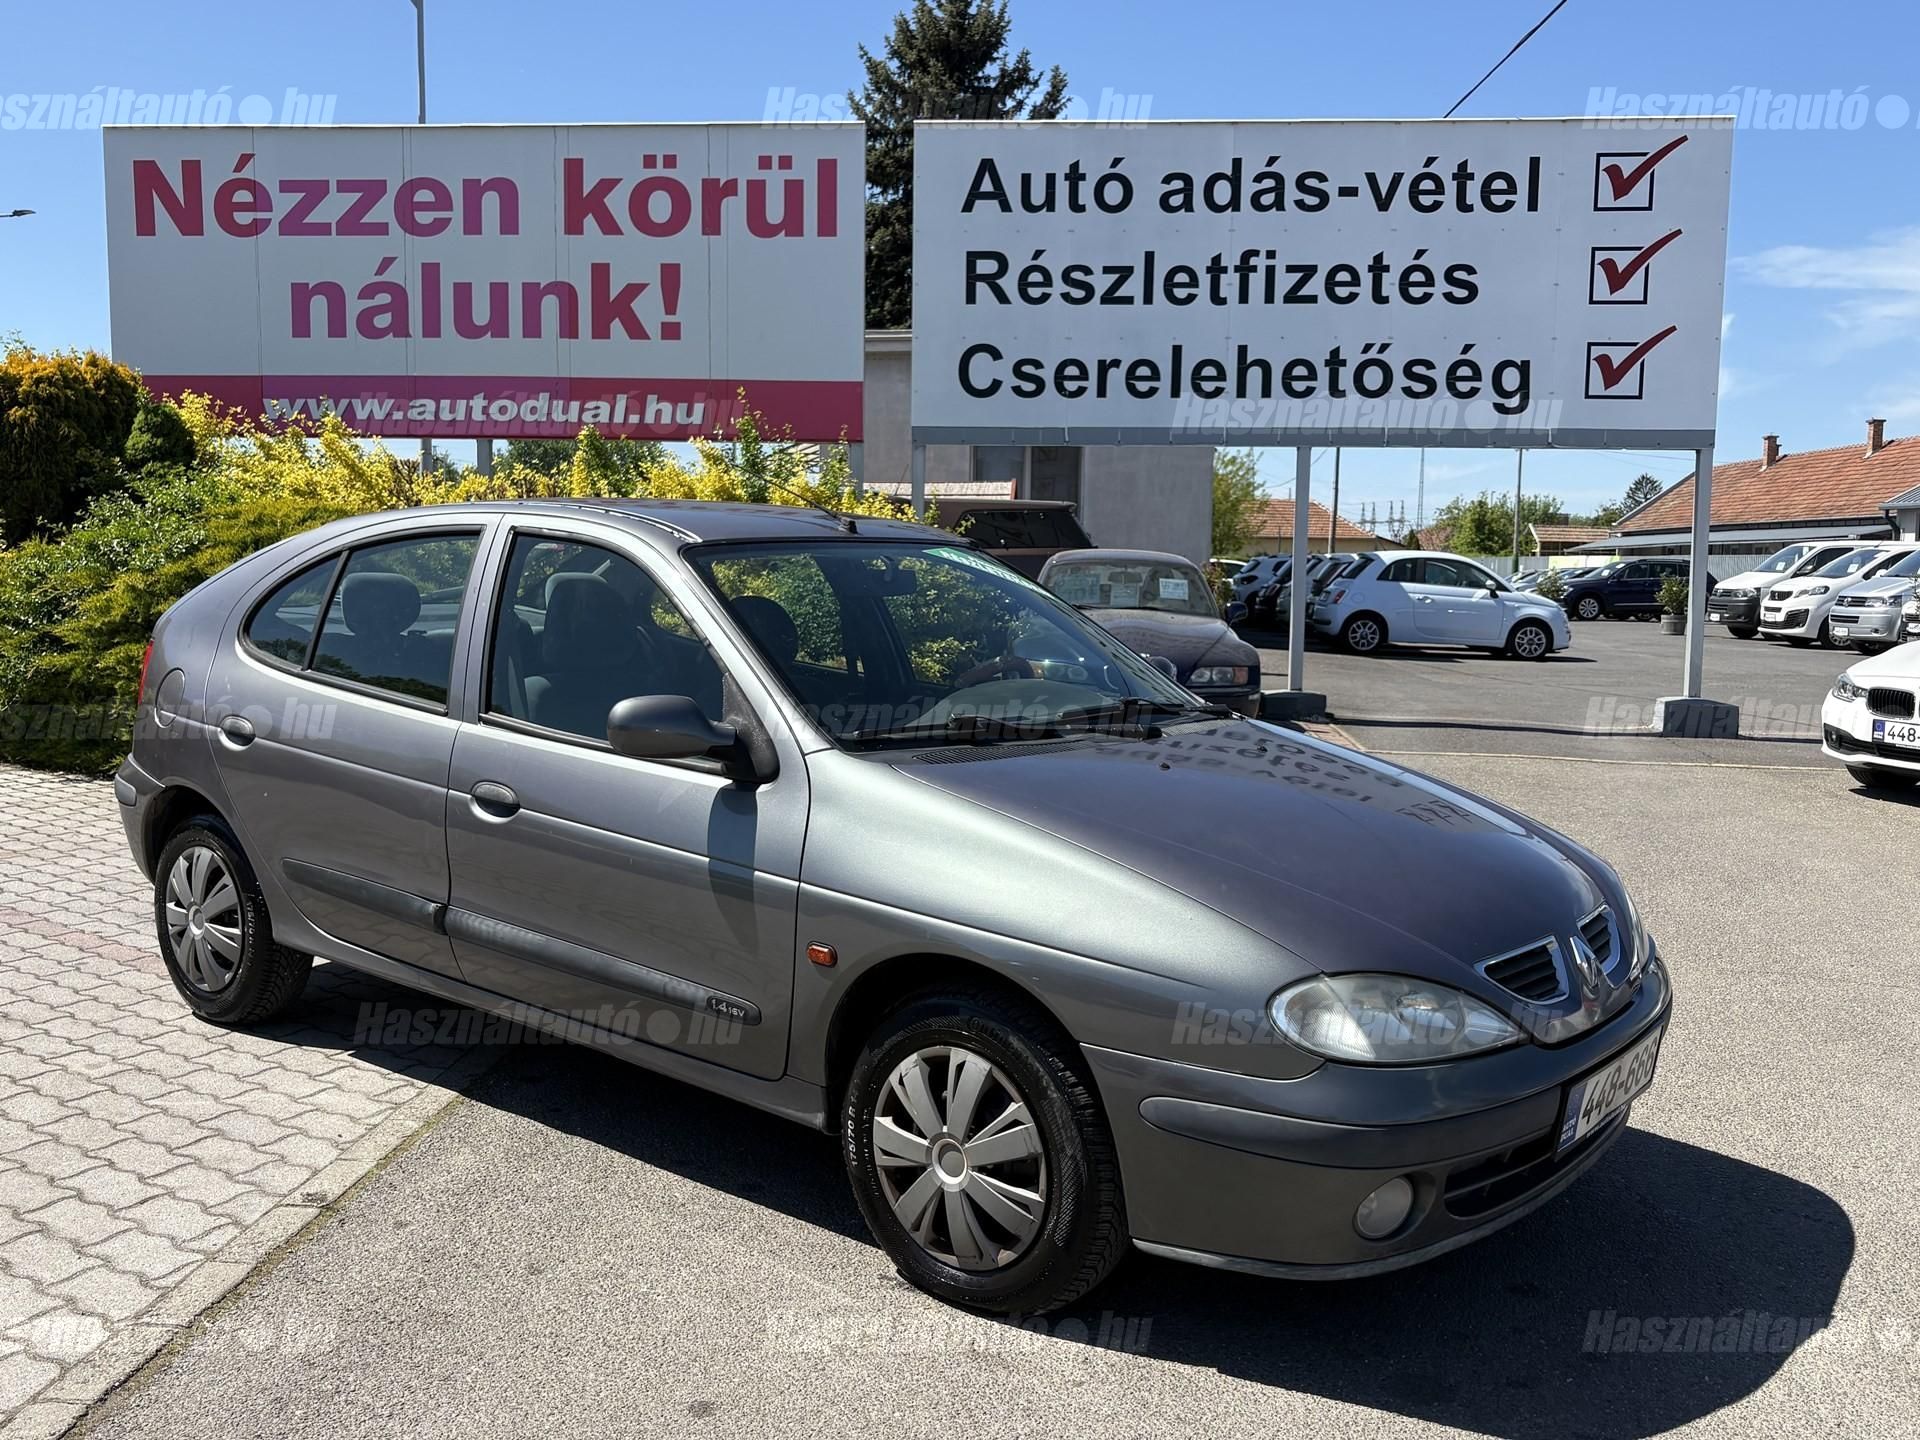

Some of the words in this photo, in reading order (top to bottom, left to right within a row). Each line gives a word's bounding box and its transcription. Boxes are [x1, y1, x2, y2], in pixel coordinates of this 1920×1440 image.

[133, 153, 520, 237] Nézzen
[564, 154, 838, 238] körül
[960, 155, 1134, 215] Autó
[1158, 155, 1541, 214] adás-vétel
[290, 256, 683, 340] nálunk!
[965, 248, 1479, 306] Részletfizetés
[263, 391, 705, 427] www.autodual.hu
[957, 341, 1532, 415] Cserelehetőség
[1581, 1036, 1659, 1125] 448-666
